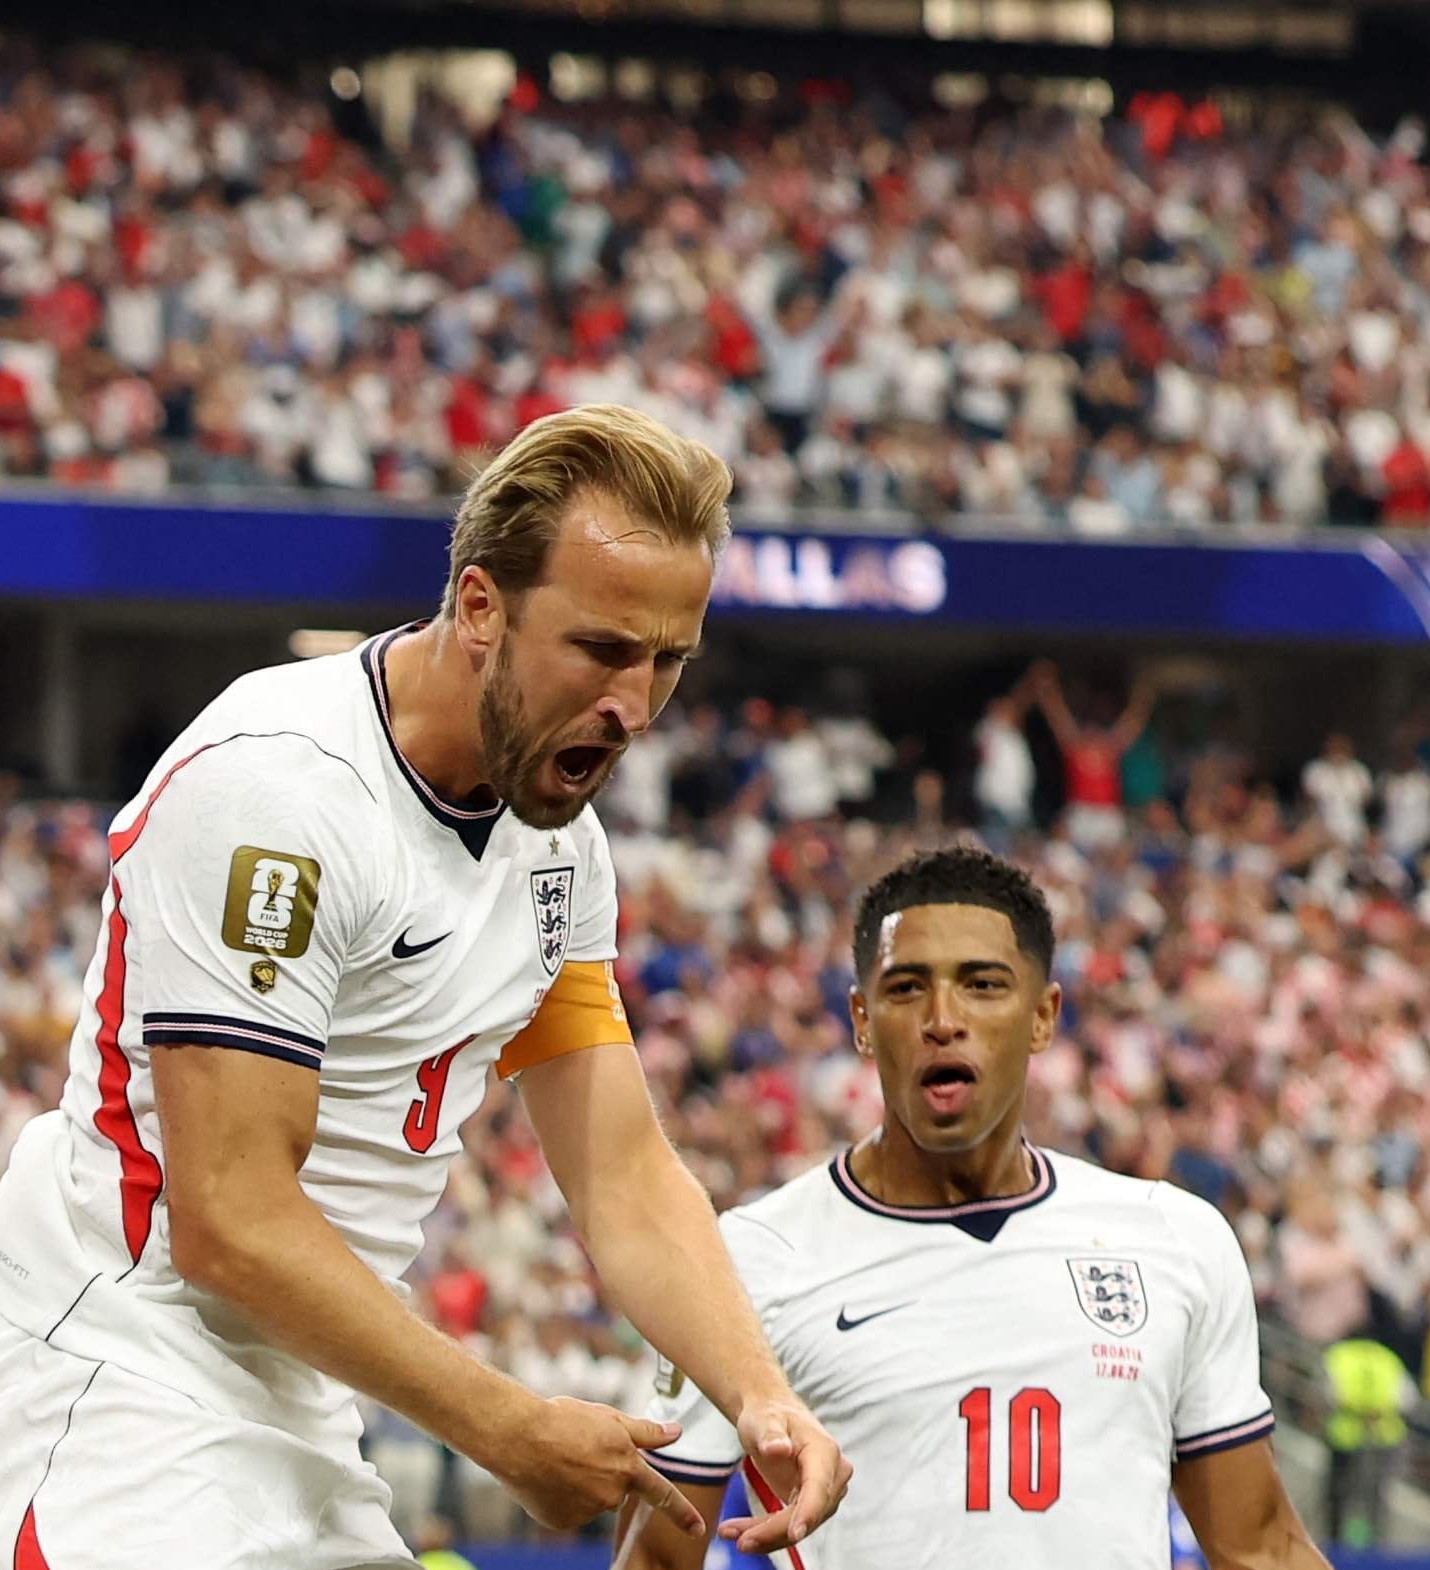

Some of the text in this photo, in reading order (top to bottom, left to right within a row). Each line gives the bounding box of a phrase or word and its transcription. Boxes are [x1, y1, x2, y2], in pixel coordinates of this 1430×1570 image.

[714, 536, 946, 613] ALLAS
[259, 912, 279, 923] FIFA
[243, 934, 287, 950] 2026
[958, 1387, 1061, 1513] 10
